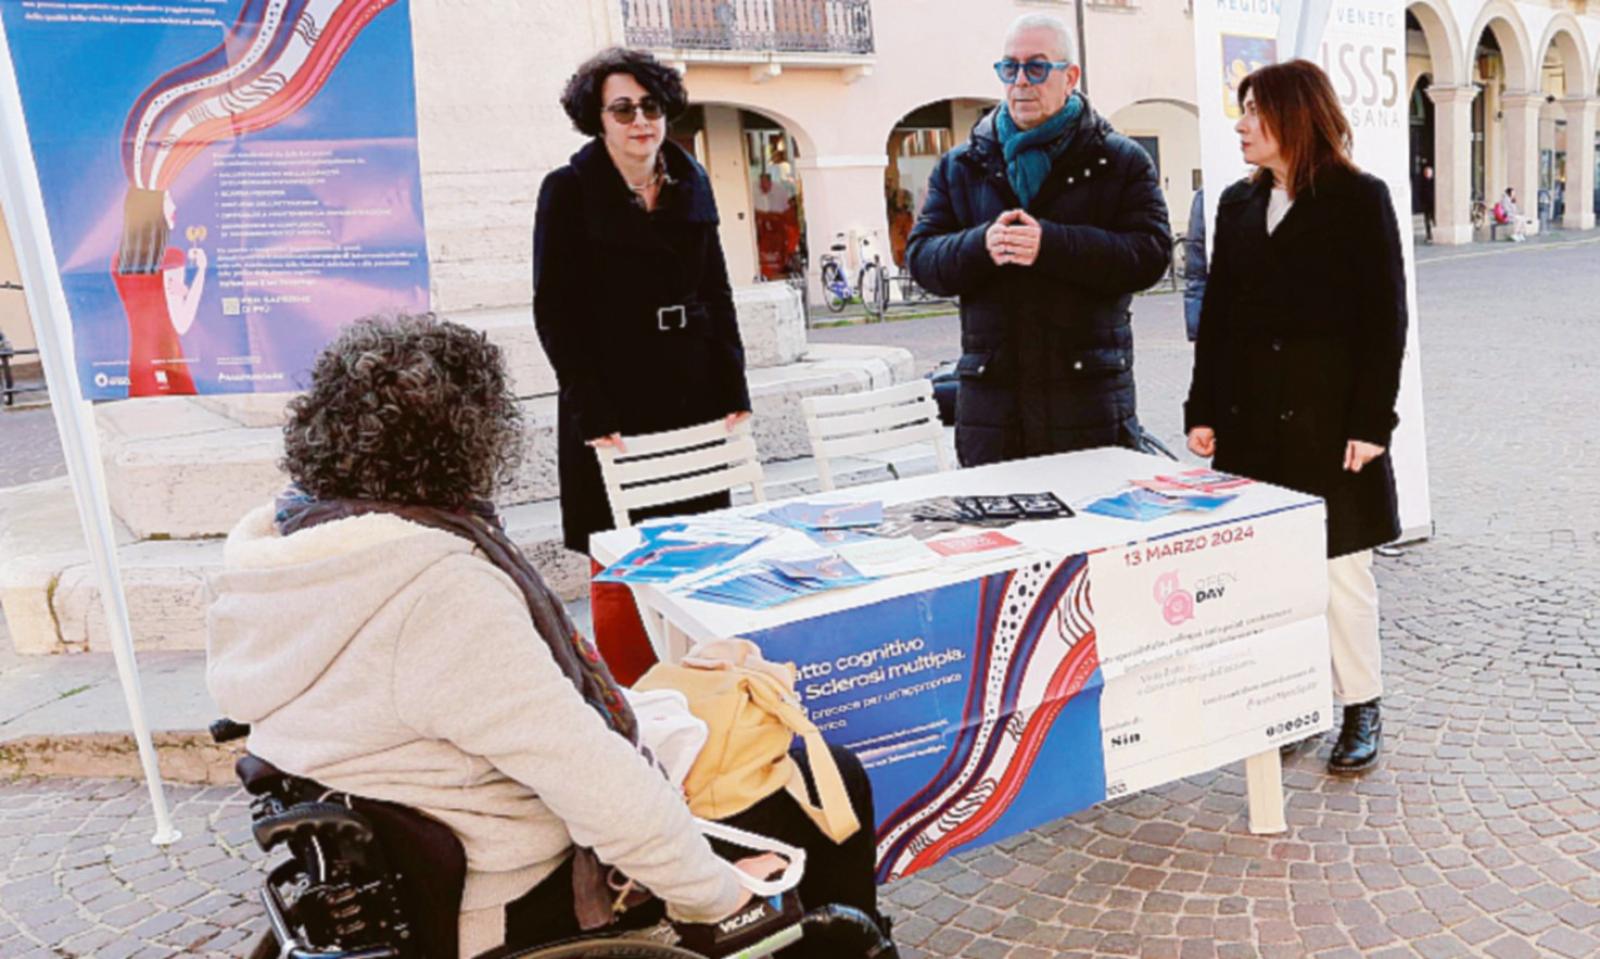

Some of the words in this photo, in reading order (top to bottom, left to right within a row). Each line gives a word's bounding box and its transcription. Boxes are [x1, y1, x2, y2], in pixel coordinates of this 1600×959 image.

[1124, 549, 1142, 567] 13
[1146, 536, 1207, 562] MARZO
[1211, 525, 1255, 547] 2024
[1196, 586, 1225, 603] DAY
[836, 637, 924, 671] cognitivo
[806, 667, 885, 700] Sclerosi
[812, 701, 861, 721] precoce
[863, 695, 882, 708] per
